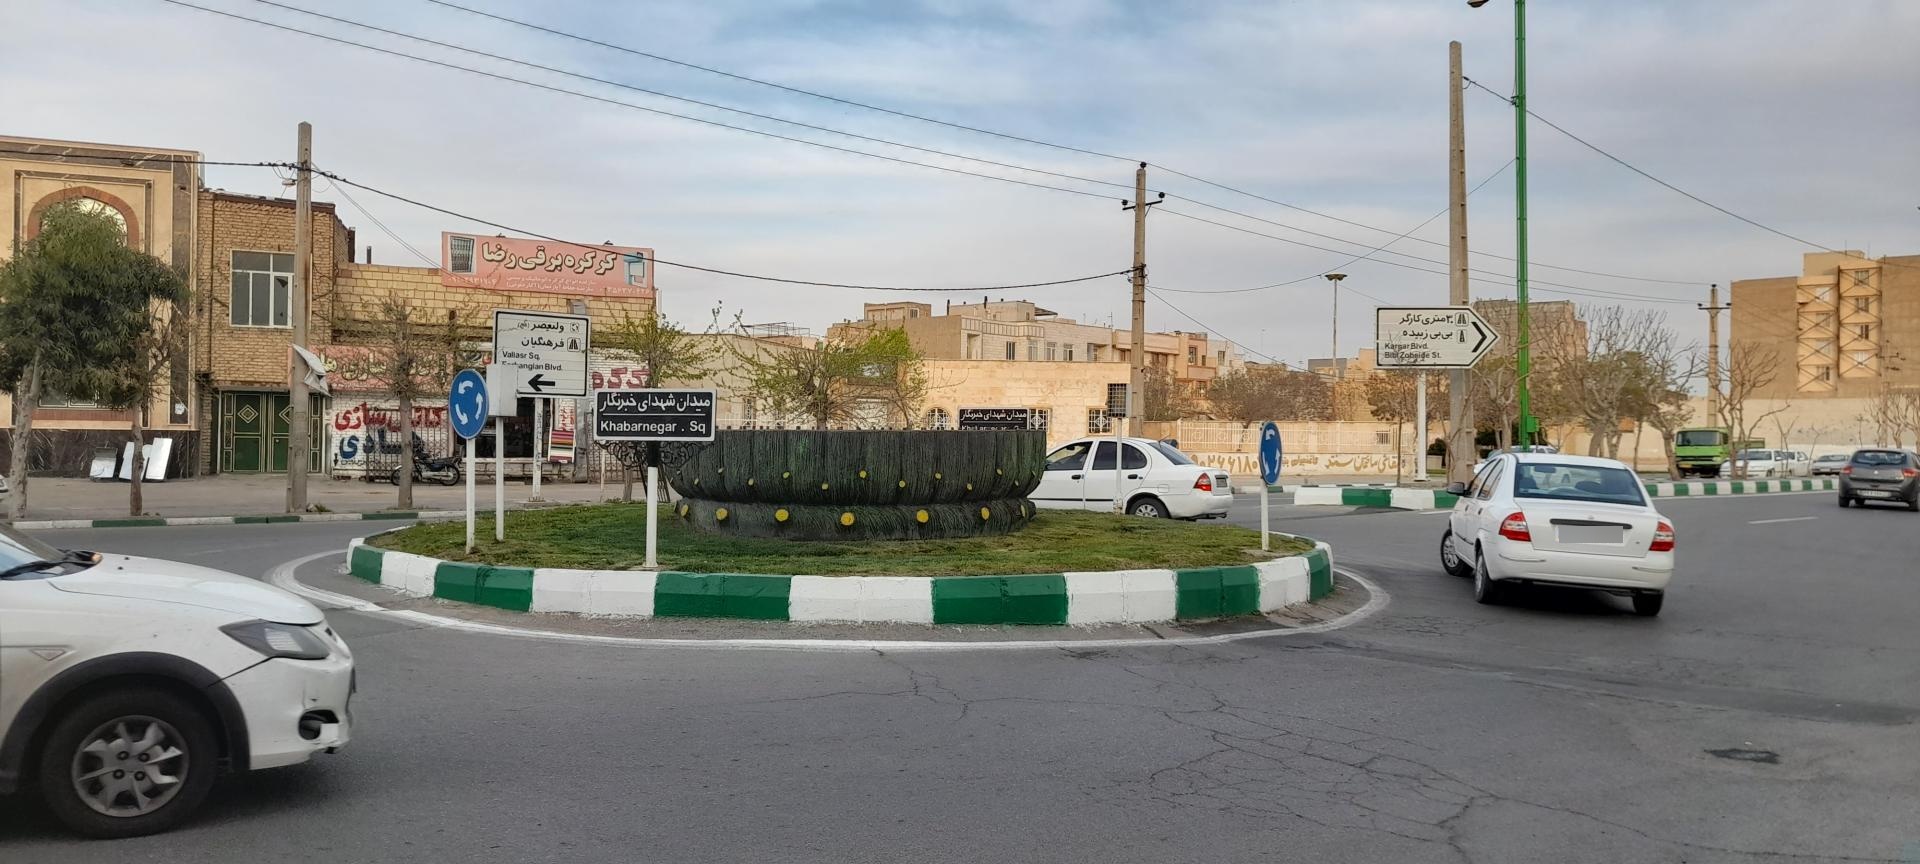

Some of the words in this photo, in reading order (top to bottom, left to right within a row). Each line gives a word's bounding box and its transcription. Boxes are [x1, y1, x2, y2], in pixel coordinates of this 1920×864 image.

[481, 241, 516, 269] رضا
[517, 245, 563, 273] برقی
[563, 250, 618, 276] کرکره
[1399, 313, 1421, 325] کارگر
[521, 336, 565, 350] فرهنگیان
[599, 391, 637, 412] خبرنگار
[637, 393, 676, 412] شهدای
[676, 393, 711, 412] میدان
[983, 409, 1006, 421] شهدای
[1006, 409, 1027, 421] میدان
[600, 420, 677, 434] Khabarnegar
[689, 420, 706, 434] Sq
